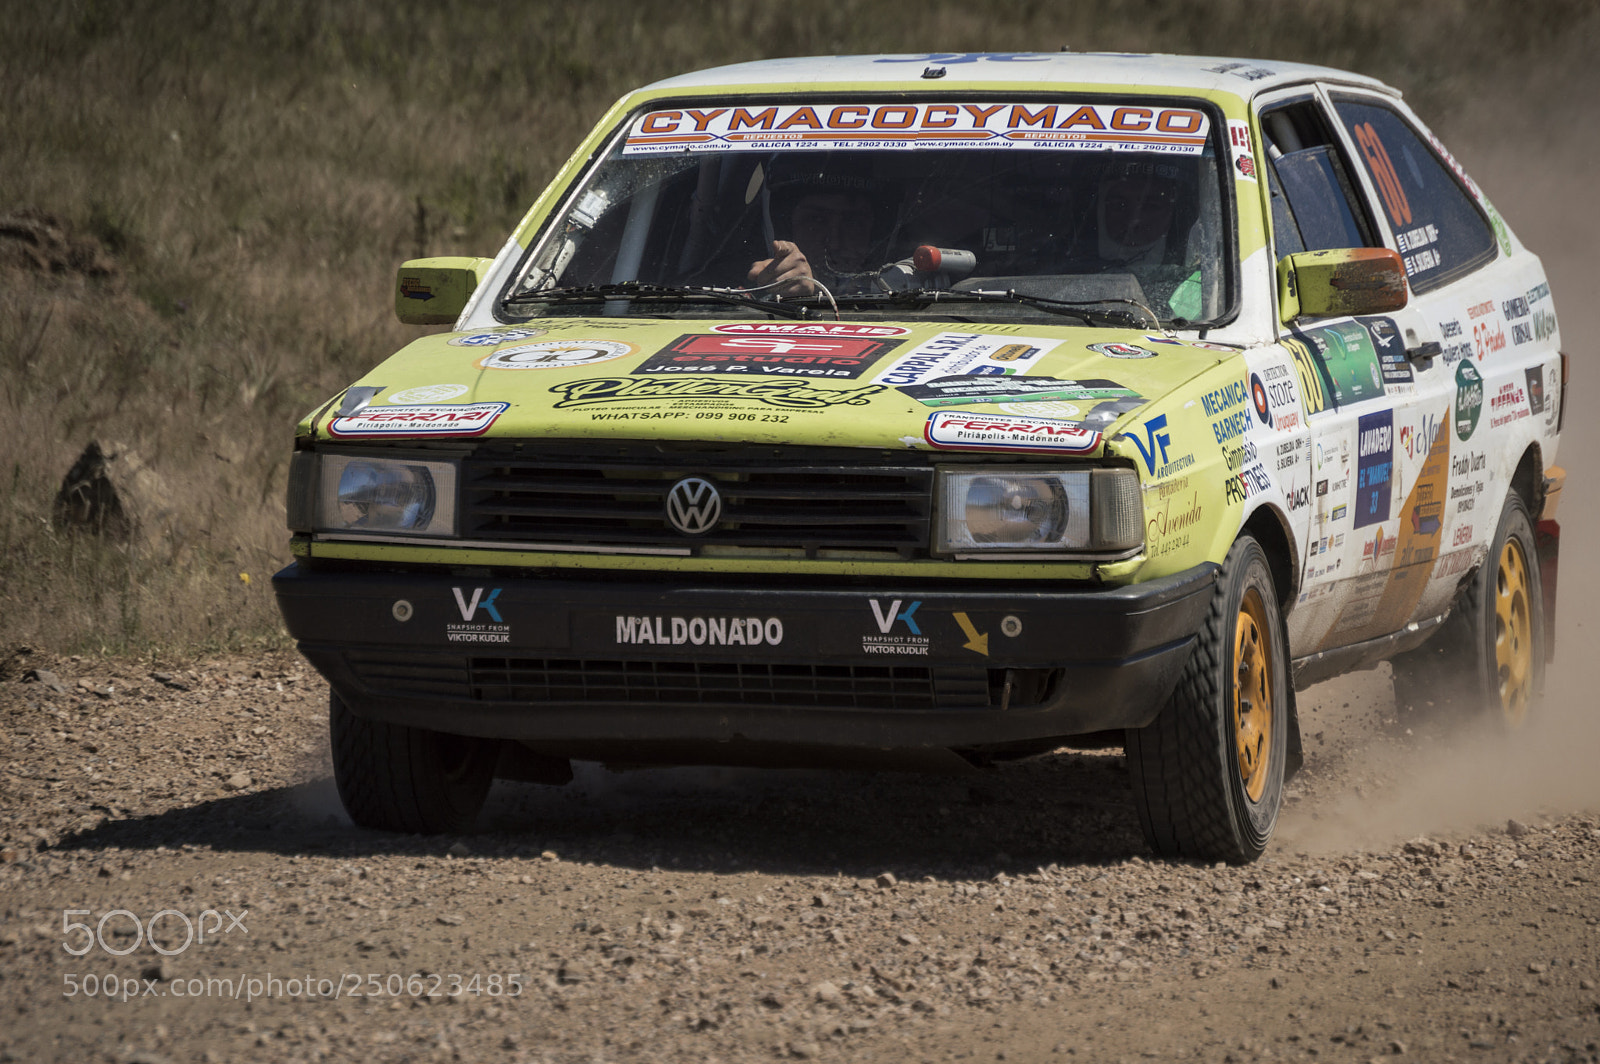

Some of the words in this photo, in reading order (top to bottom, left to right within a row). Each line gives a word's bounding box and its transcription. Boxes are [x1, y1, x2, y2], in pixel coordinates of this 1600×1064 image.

[640, 106, 918, 134] CYMACO
[920, 104, 1204, 133] CYMACO
[1024, 132, 1087, 140] REPUESTOS
[722, 325, 898, 335] AMALIE
[672, 355, 861, 366] estudio
[881, 352, 950, 385] CARPAL
[761, 366, 851, 377] Varela
[1263, 364, 1289, 383] DETECTOR
[1201, 379, 1249, 418] MECANICA
[1268, 378, 1296, 409] store
[345, 411, 490, 422] FERRARI
[409, 421, 460, 429] Maldonado
[592, 412, 691, 421] WHATSAPP:
[695, 412, 723, 420] 099
[728, 413, 756, 421] 906
[761, 414, 790, 424] 232
[943, 413, 1012, 422] TRANSPORTES
[1273, 411, 1300, 433] Uruguay
[940, 420, 1088, 437] FERRARI
[1212, 408, 1254, 445] BARNECH
[1012, 434, 1065, 443] Maldonado
[1360, 425, 1392, 457] LAVADERO
[1221, 436, 1258, 472] Gimnasio
[1156, 452, 1196, 480] ARQUITECTURA
[1225, 462, 1272, 507] PROFITNESS
[1148, 490, 1202, 543] Avenida
[447, 634, 478, 643] VIKTOR
[479, 634, 510, 643] KUDLIK
[615, 616, 784, 647] MALDONADO
[862, 636, 904, 644] SNAPSHOT
[907, 637, 930, 645] FROM
[862, 645, 896, 655] VIKTOR
[896, 645, 929, 656] KUDLIK
